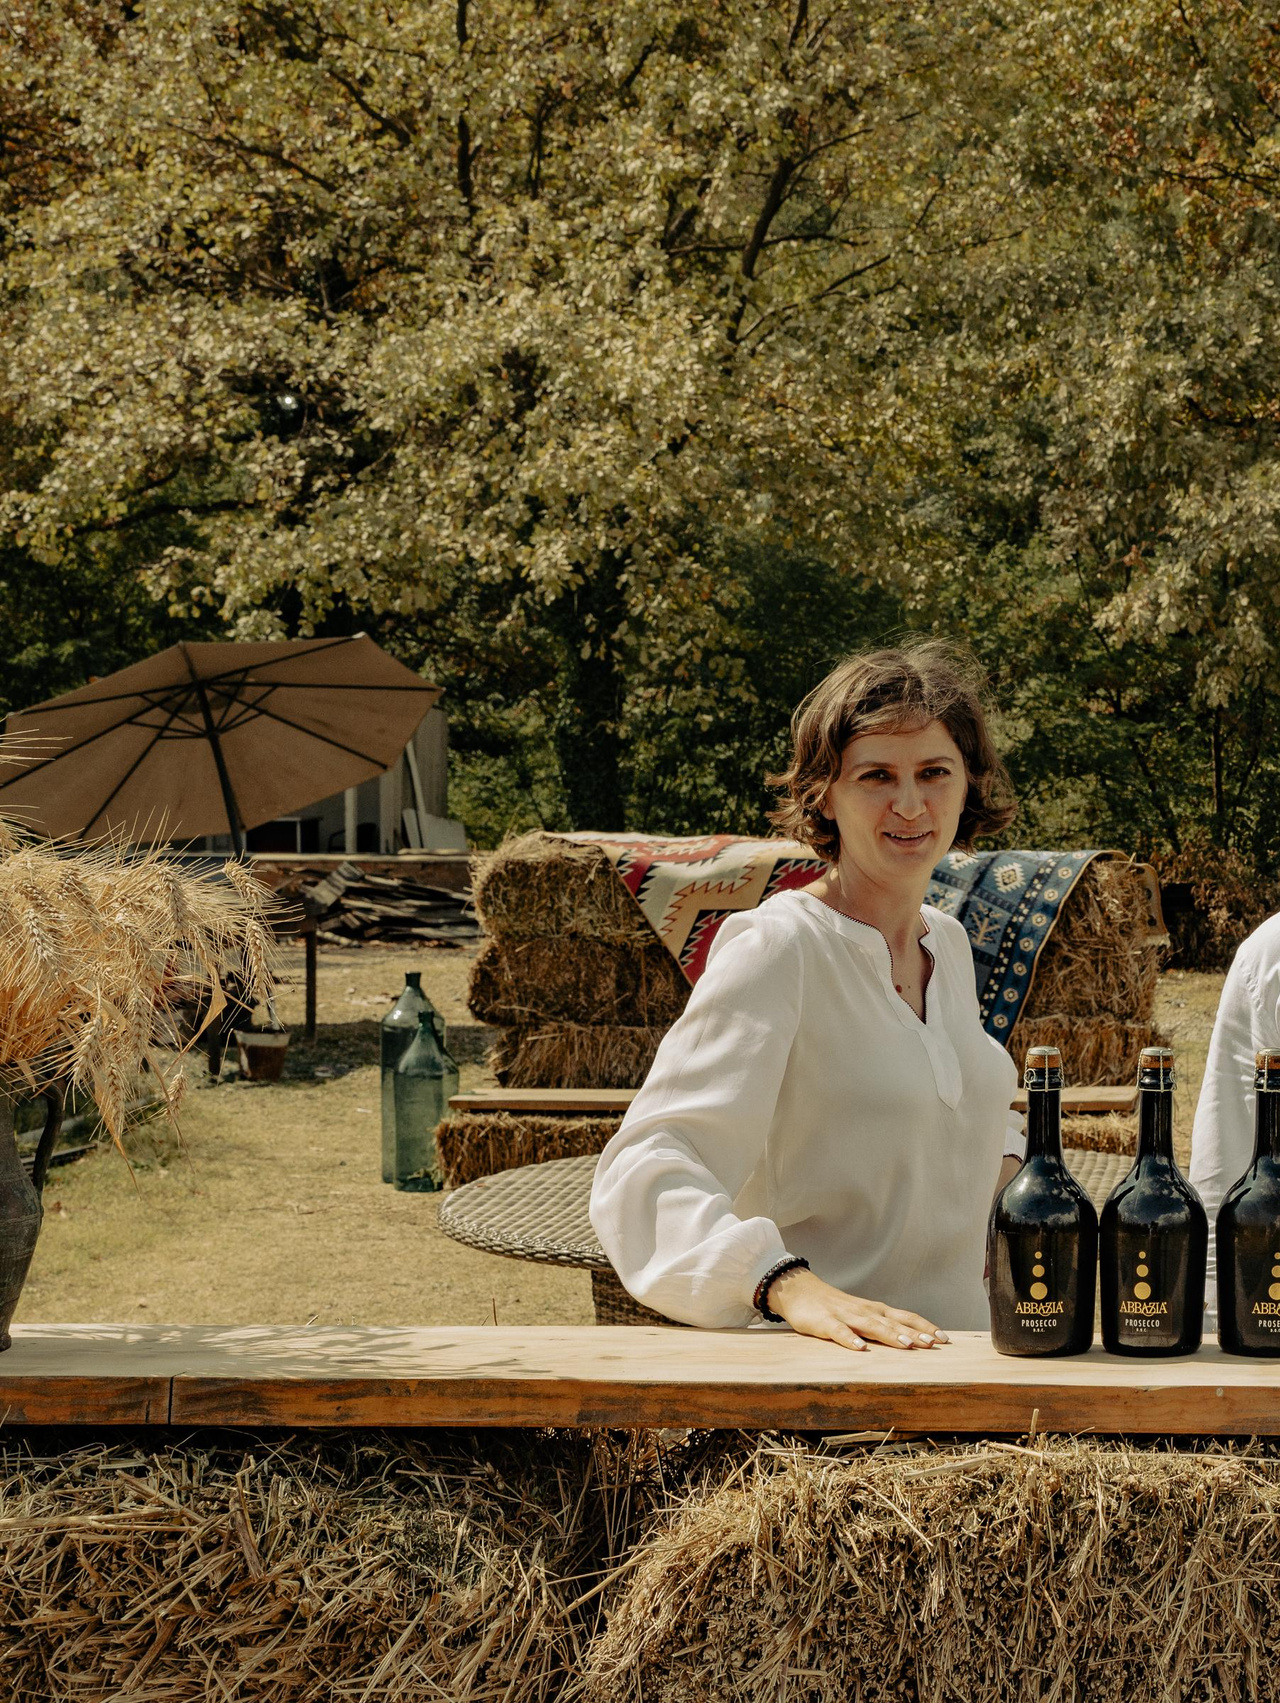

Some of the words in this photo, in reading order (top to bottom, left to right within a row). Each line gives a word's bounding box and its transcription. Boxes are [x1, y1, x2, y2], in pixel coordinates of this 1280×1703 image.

[1015, 1301, 1064, 1317] ABBAZIA
[1119, 1301, 1168, 1317] ABBAZIA
[1021, 1319, 1057, 1327] PROSECCO
[1125, 1318, 1160, 1328] PROSECCO
